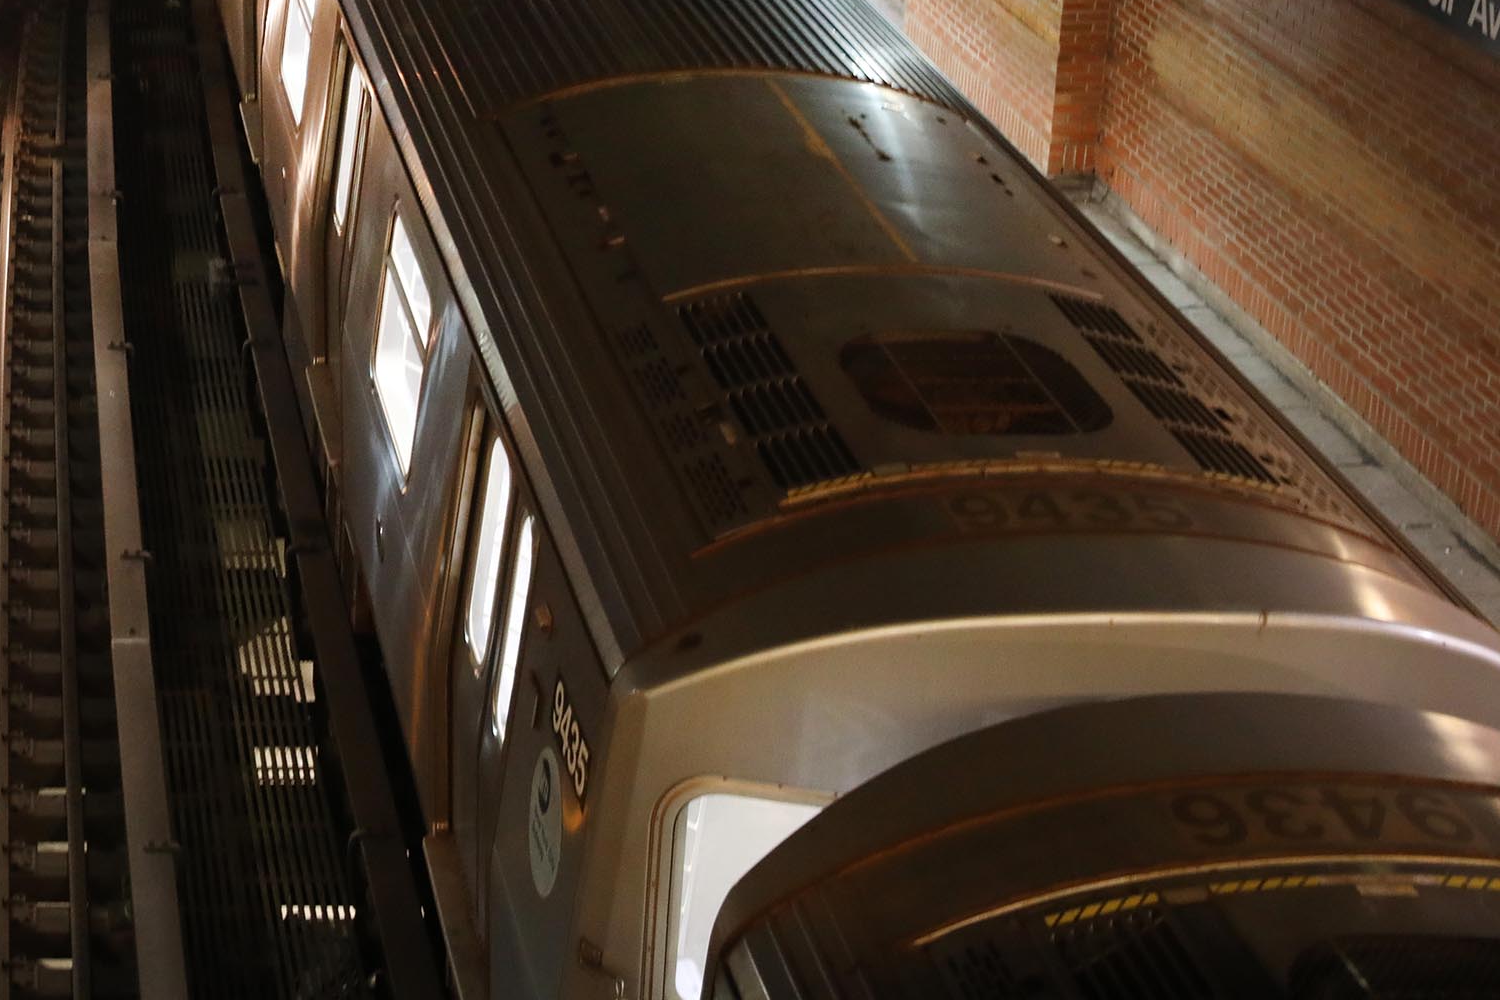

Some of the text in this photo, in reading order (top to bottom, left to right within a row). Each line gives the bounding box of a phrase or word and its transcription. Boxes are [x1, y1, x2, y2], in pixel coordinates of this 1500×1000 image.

[949, 489, 1196, 531] 9435
[552, 679, 589, 799] 9435
[1169, 789, 1474, 846] 9436
